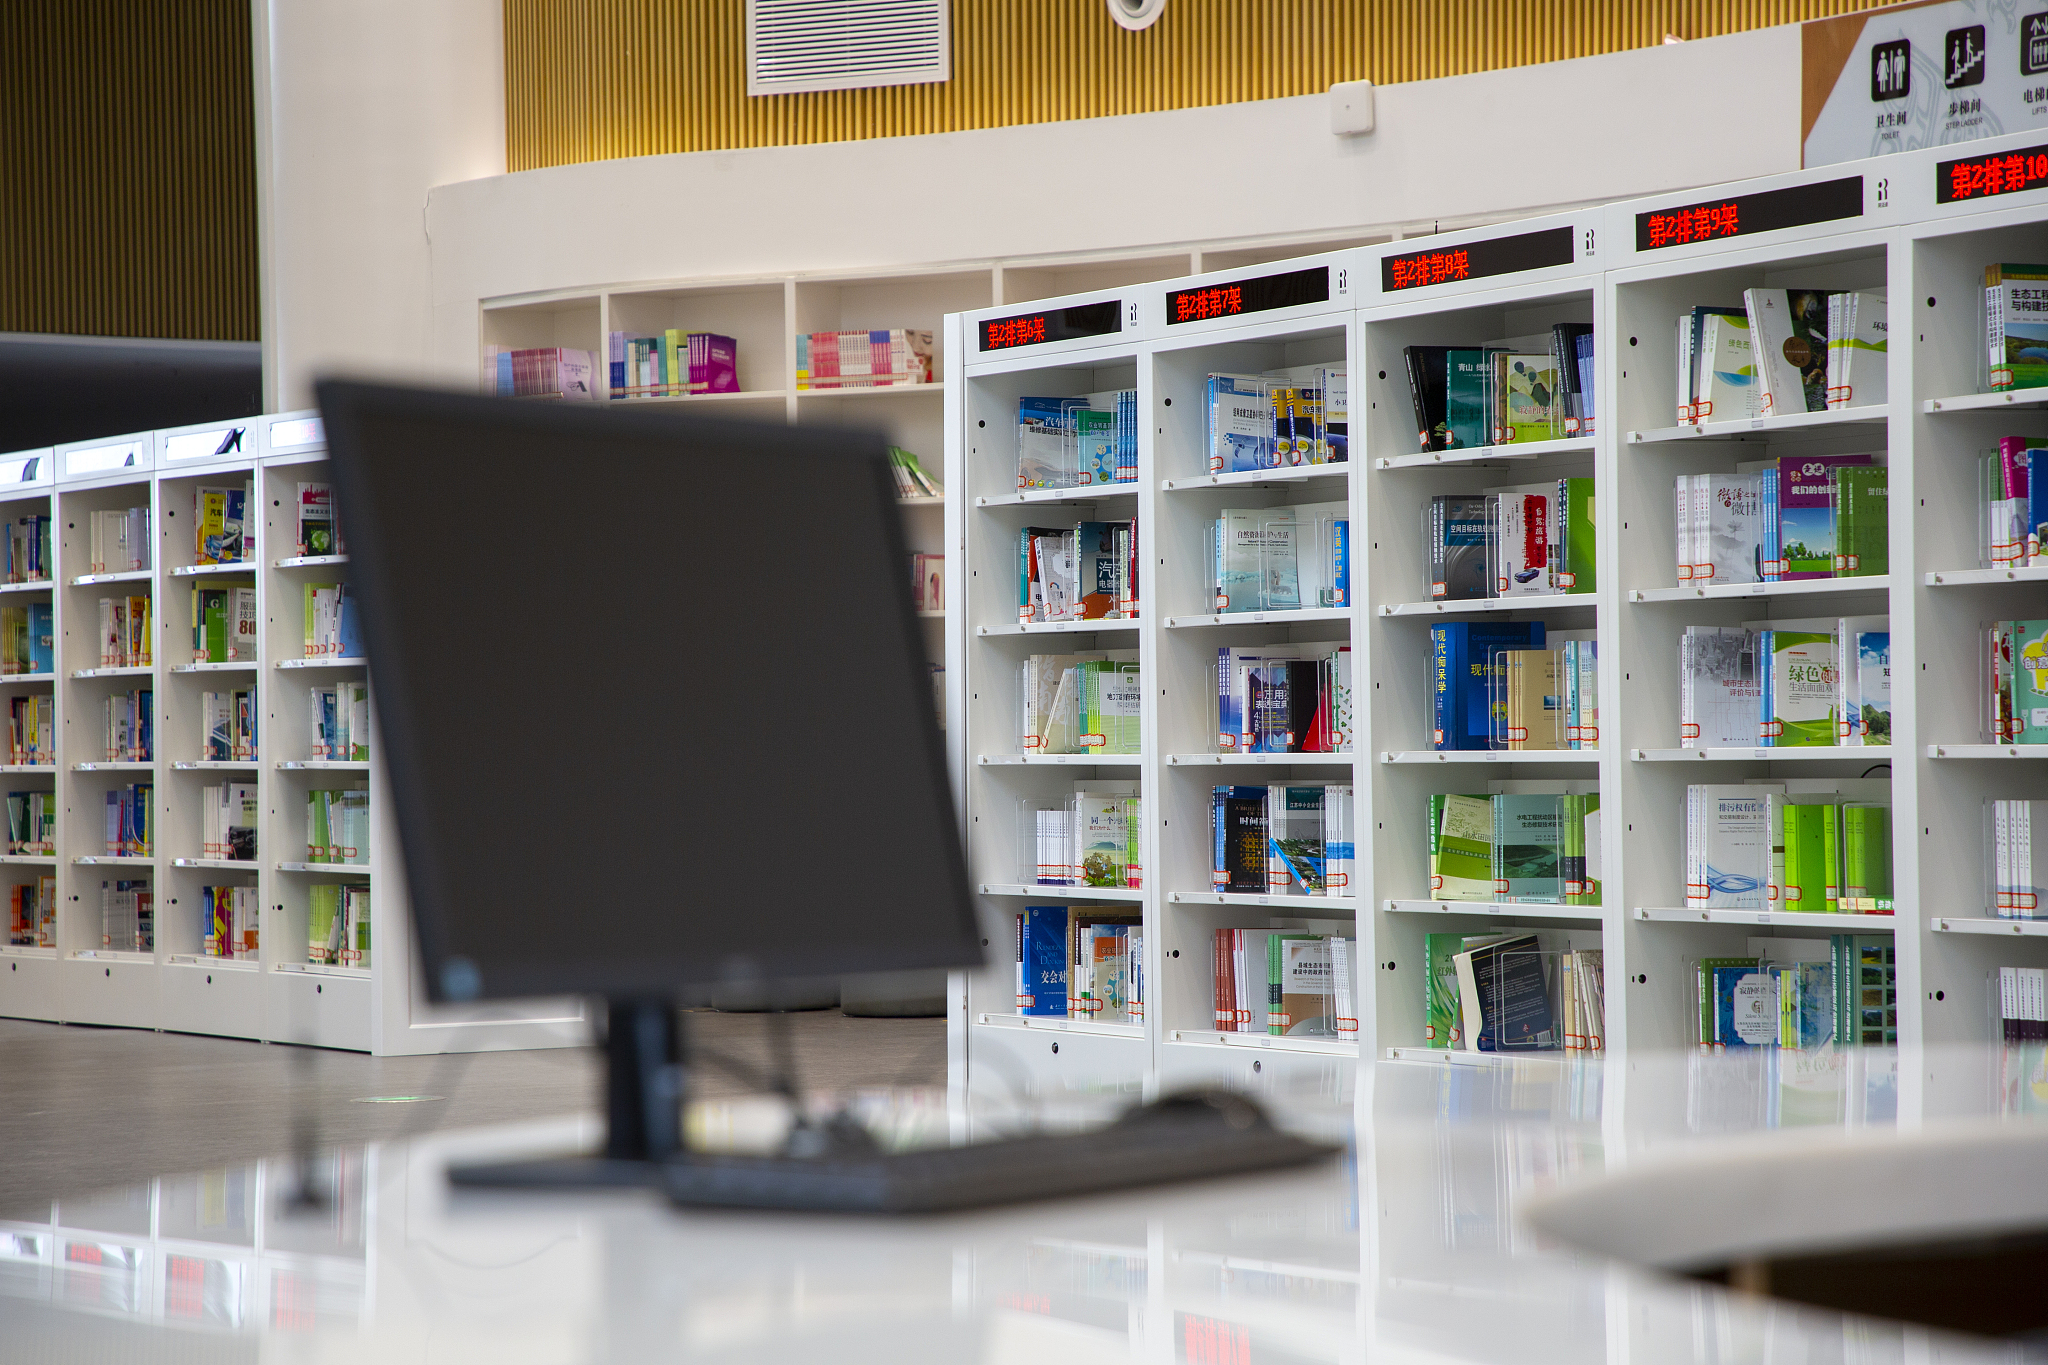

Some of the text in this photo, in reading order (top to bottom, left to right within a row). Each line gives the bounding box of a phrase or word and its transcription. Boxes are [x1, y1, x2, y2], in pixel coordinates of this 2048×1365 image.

[2023, 86, 2048, 104] 电梯
[1949, 98, 1981, 118] 步梯间
[2031, 106, 2047, 116] LIFTS
[1876, 111, 1907, 129] 卫生间
[1881, 131, 1900, 140] TOILET
[1647, 203, 1740, 248] 第2排第9架
[1391, 249, 1470, 290] 第2排第8架
[1175, 285, 1243, 322] 第2排第7架
[987, 316, 1046, 350] 第2排第6架
[1471, 634, 1527, 642] Contemporary
[1437, 630, 1446, 694] 现代痴呆学
